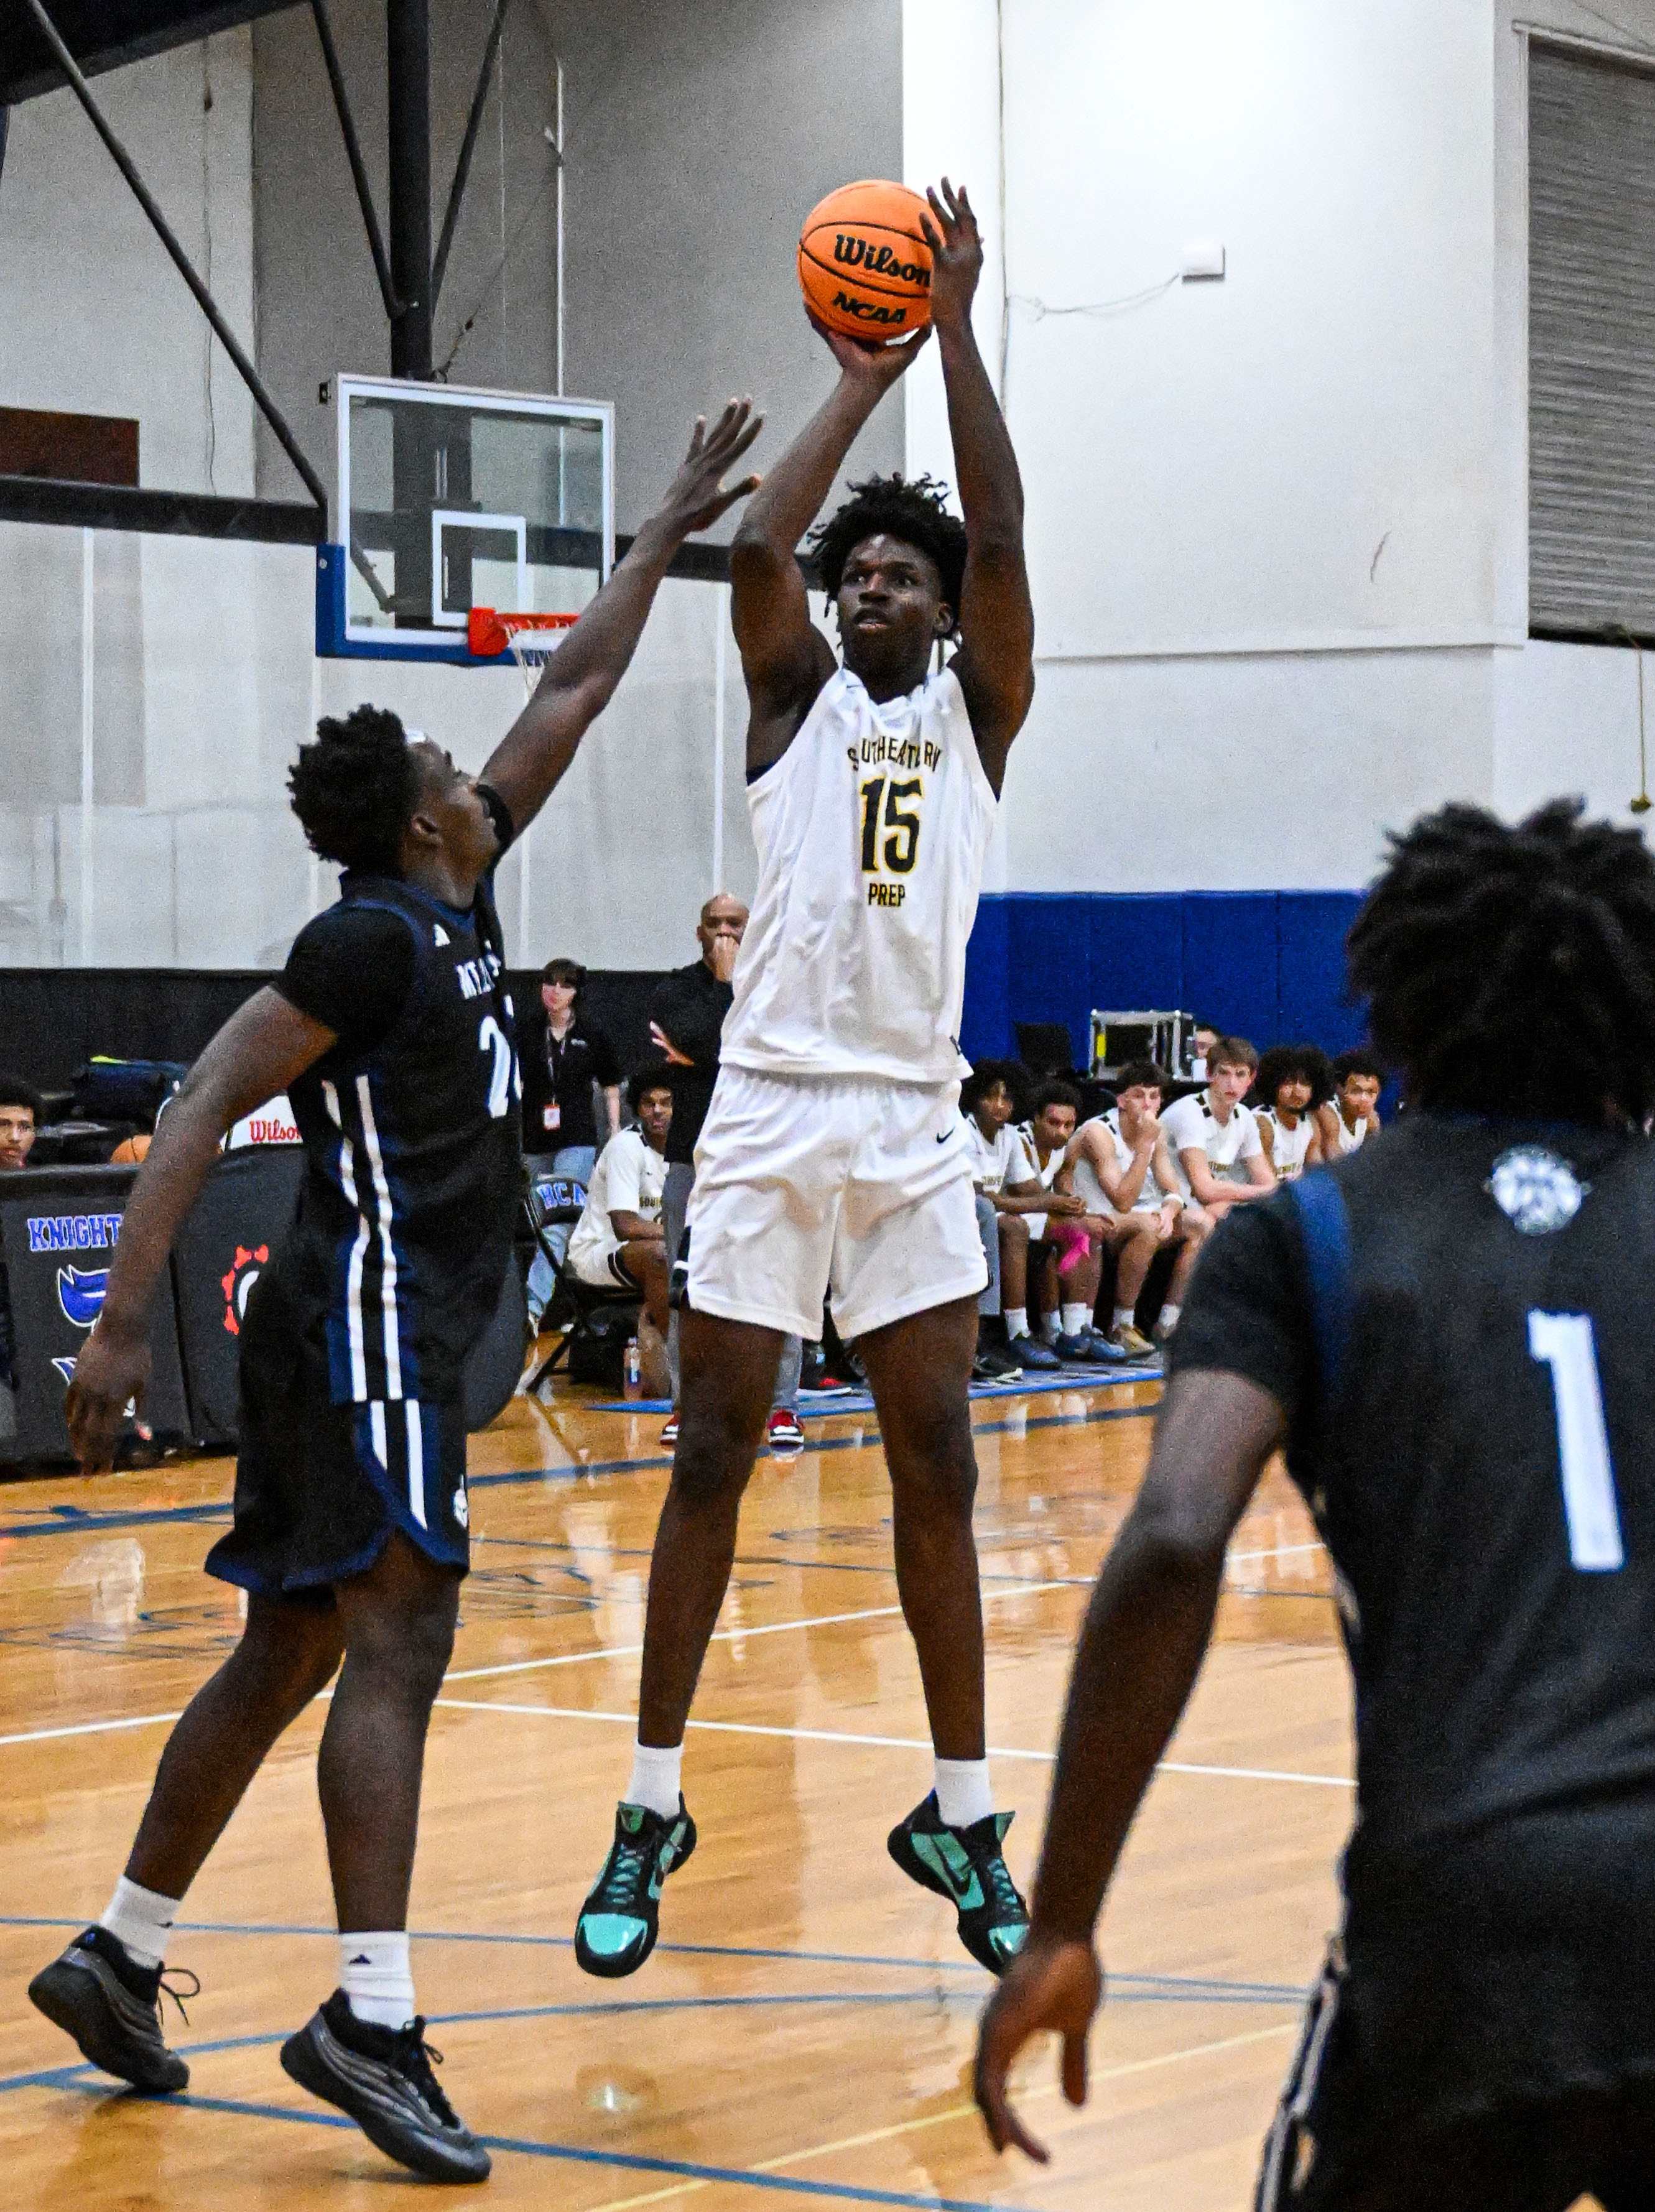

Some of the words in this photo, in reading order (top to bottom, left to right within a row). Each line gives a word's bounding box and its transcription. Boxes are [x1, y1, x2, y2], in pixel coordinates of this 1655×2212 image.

[834, 234, 930, 287] Wilson
[833, 291, 907, 324] NCAA
[860, 775, 924, 874] 15
[868, 882, 906, 907] PREP
[1528, 1309, 1625, 1571] 1
